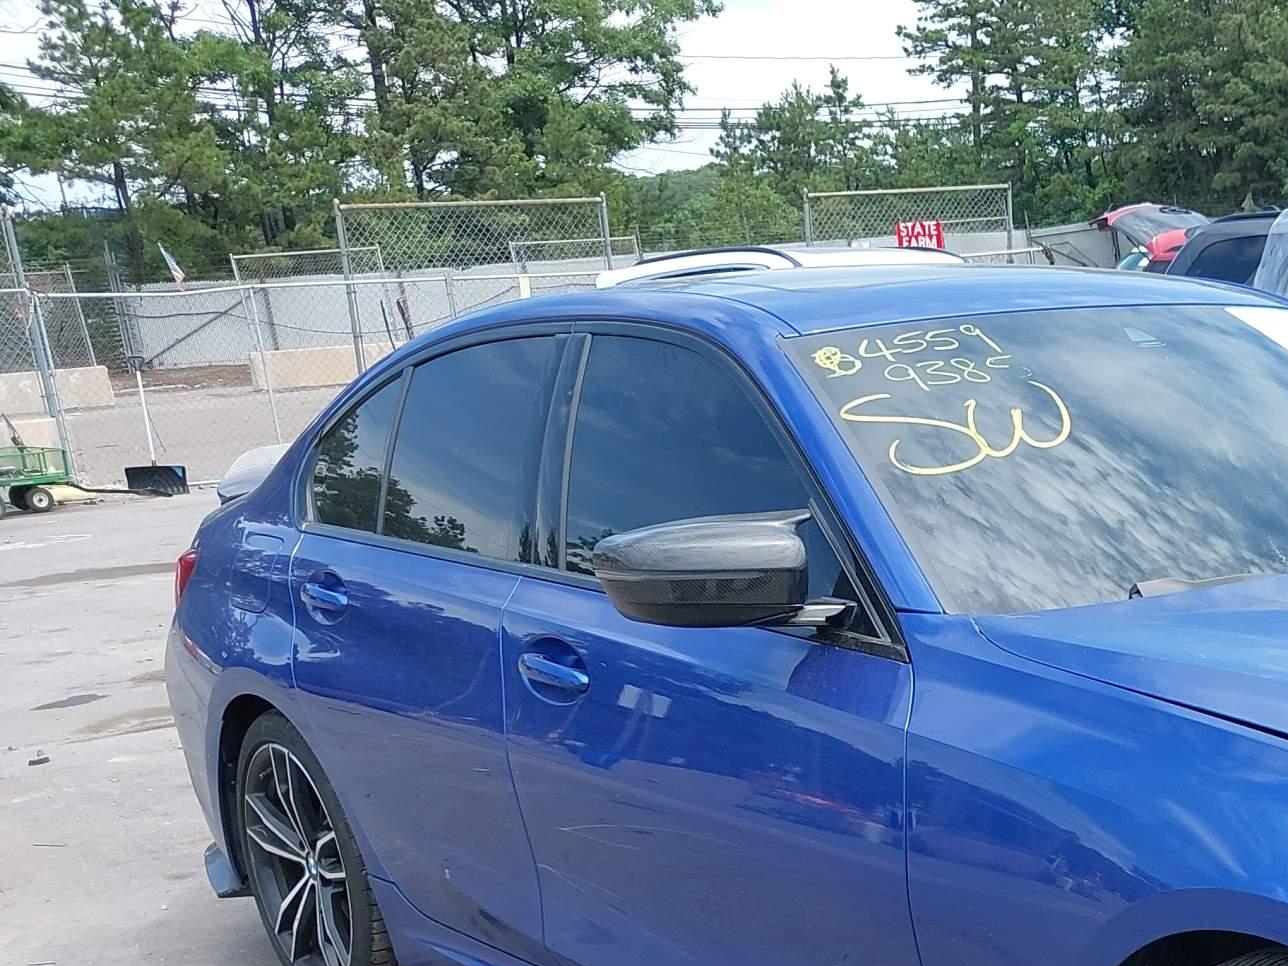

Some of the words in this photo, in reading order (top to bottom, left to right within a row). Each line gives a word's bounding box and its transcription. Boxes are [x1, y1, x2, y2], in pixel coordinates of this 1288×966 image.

[900, 222, 938, 236] STATE
[902, 236, 938, 248] FARM
[840, 381, 1071, 475] SW
